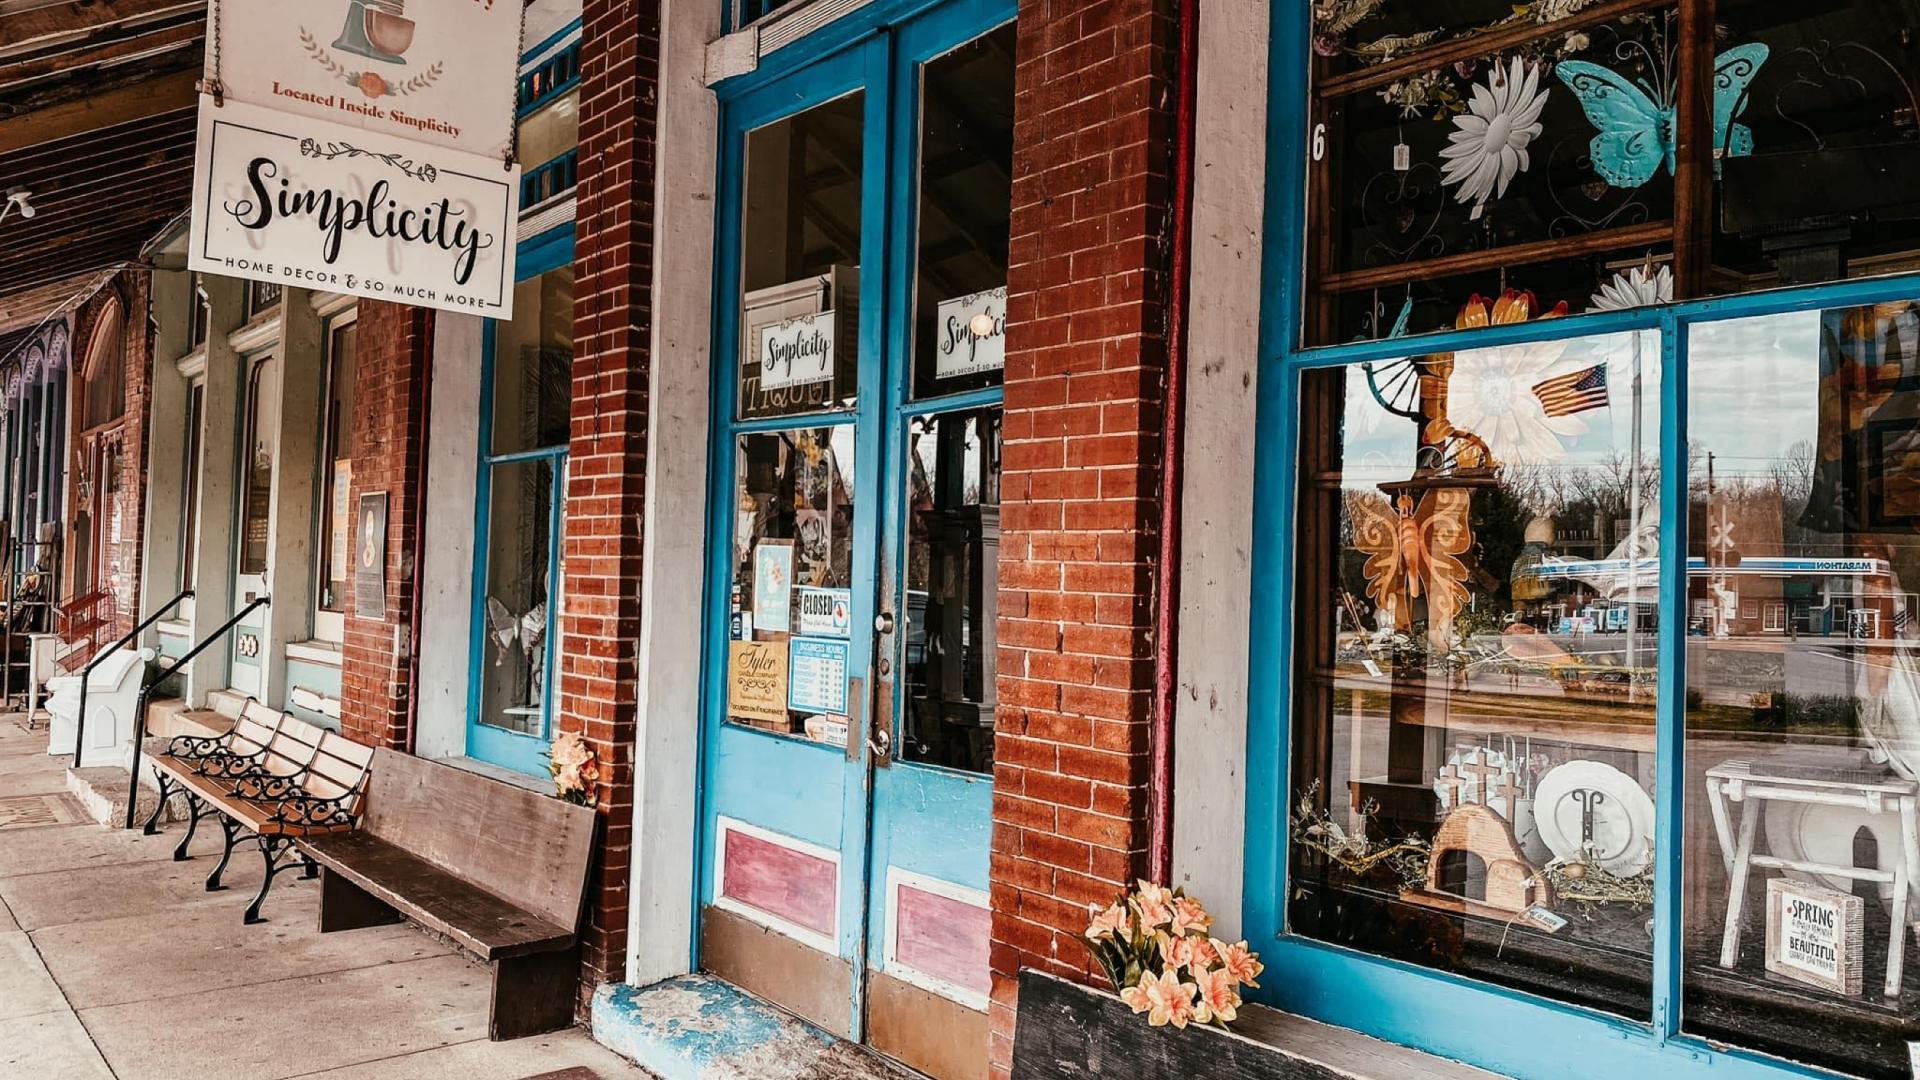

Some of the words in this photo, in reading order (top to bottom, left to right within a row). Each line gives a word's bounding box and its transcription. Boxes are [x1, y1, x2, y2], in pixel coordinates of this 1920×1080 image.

[272, 81, 334, 107] Located
[339, 97, 385, 119] Inside
[390, 109, 461, 139] Simplicity
[1312, 123, 1326, 161] 6
[223, 157, 493, 285] Simplicity
[225, 257, 274, 275] HOME
[284, 266, 338, 285] DECOR
[344, 274, 359, 289] &
[365, 279, 385, 292] SO
[394, 285, 436, 301] MUCH
[445, 293, 485, 309] MORE
[763, 329, 832, 378] Simplicity
[803, 594, 833, 616] CLOSED
[738, 644, 776, 676] Tyler
[1792, 899, 1834, 929] SPRING
[1789, 936, 1836, 962] BEAUTIFUL
